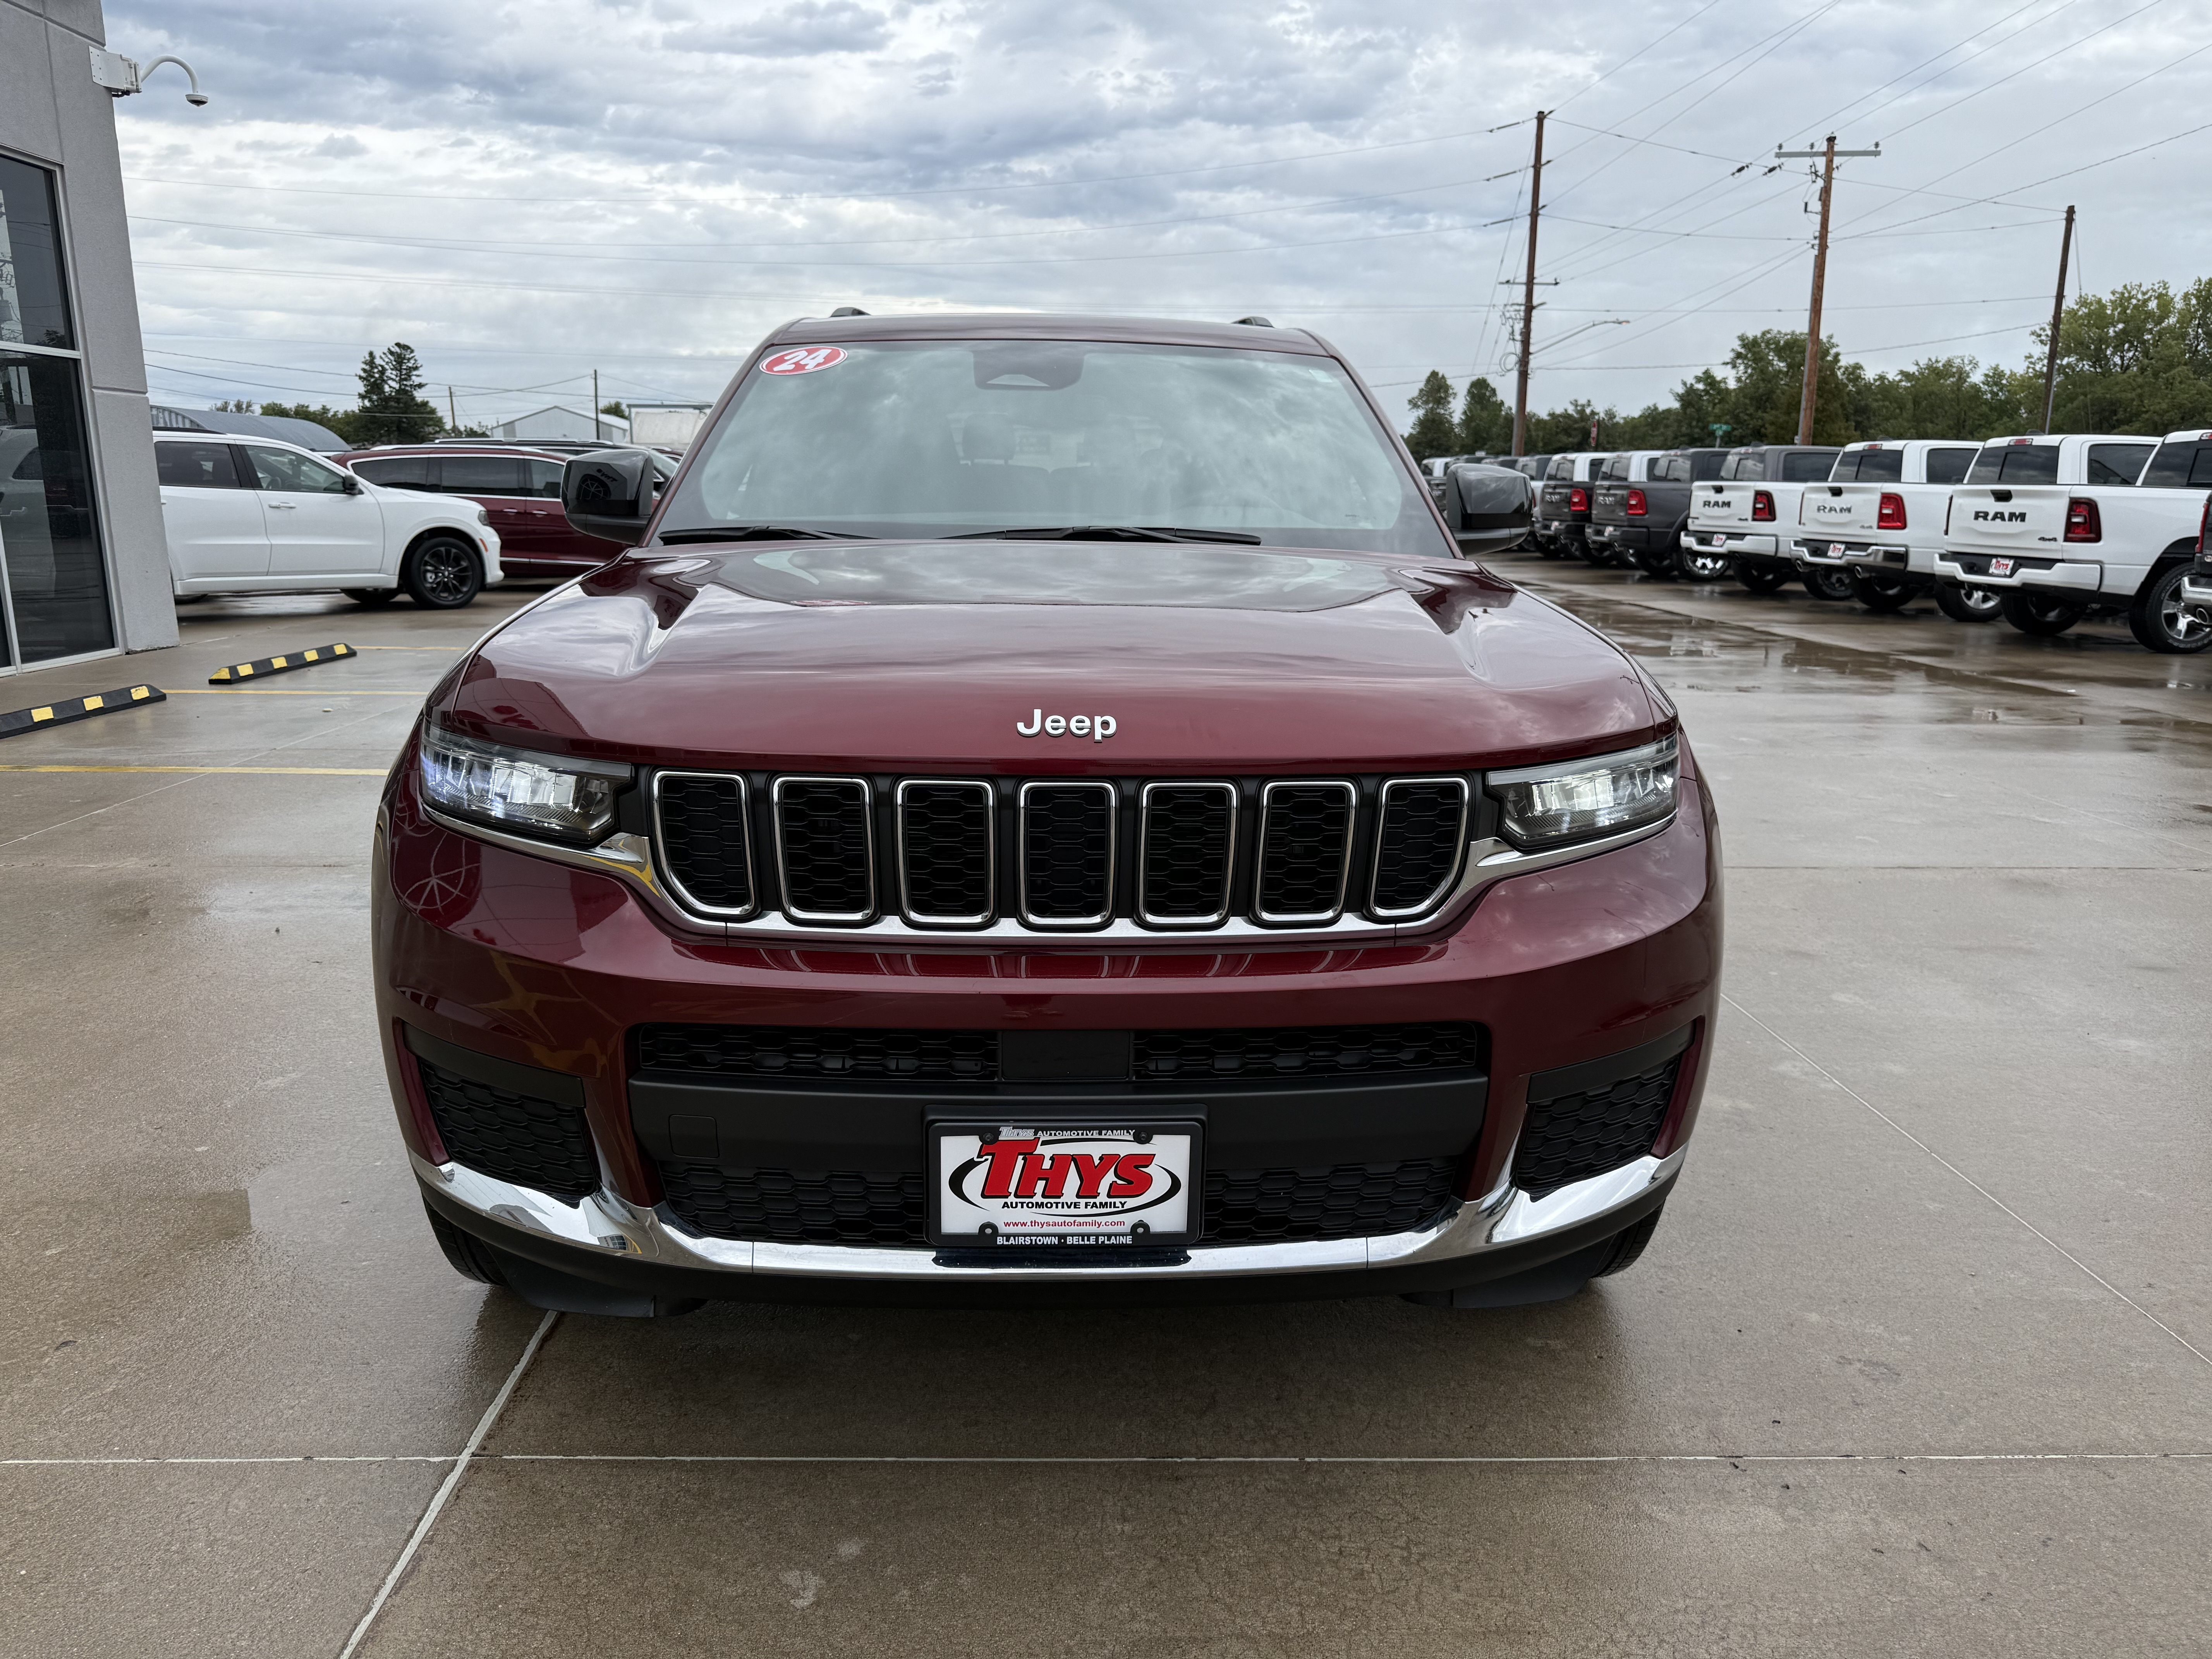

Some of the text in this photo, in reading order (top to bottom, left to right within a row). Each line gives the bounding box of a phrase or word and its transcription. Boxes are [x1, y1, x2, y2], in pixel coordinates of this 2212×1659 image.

[773, 349, 832, 371] 24
[1703, 500, 1731, 508] RAM
[1817, 505, 1852, 514] RAM
[1973, 510, 2026, 522] RAM
[1017, 709, 1117, 743] Jeep
[1084, 1201, 1128, 1209] FAMILY
[1004, 1220, 1125, 1228] www.thysautofamily.com
[997, 1236, 1132, 1245] BLAIRSTOWN BELLE PLAINE
